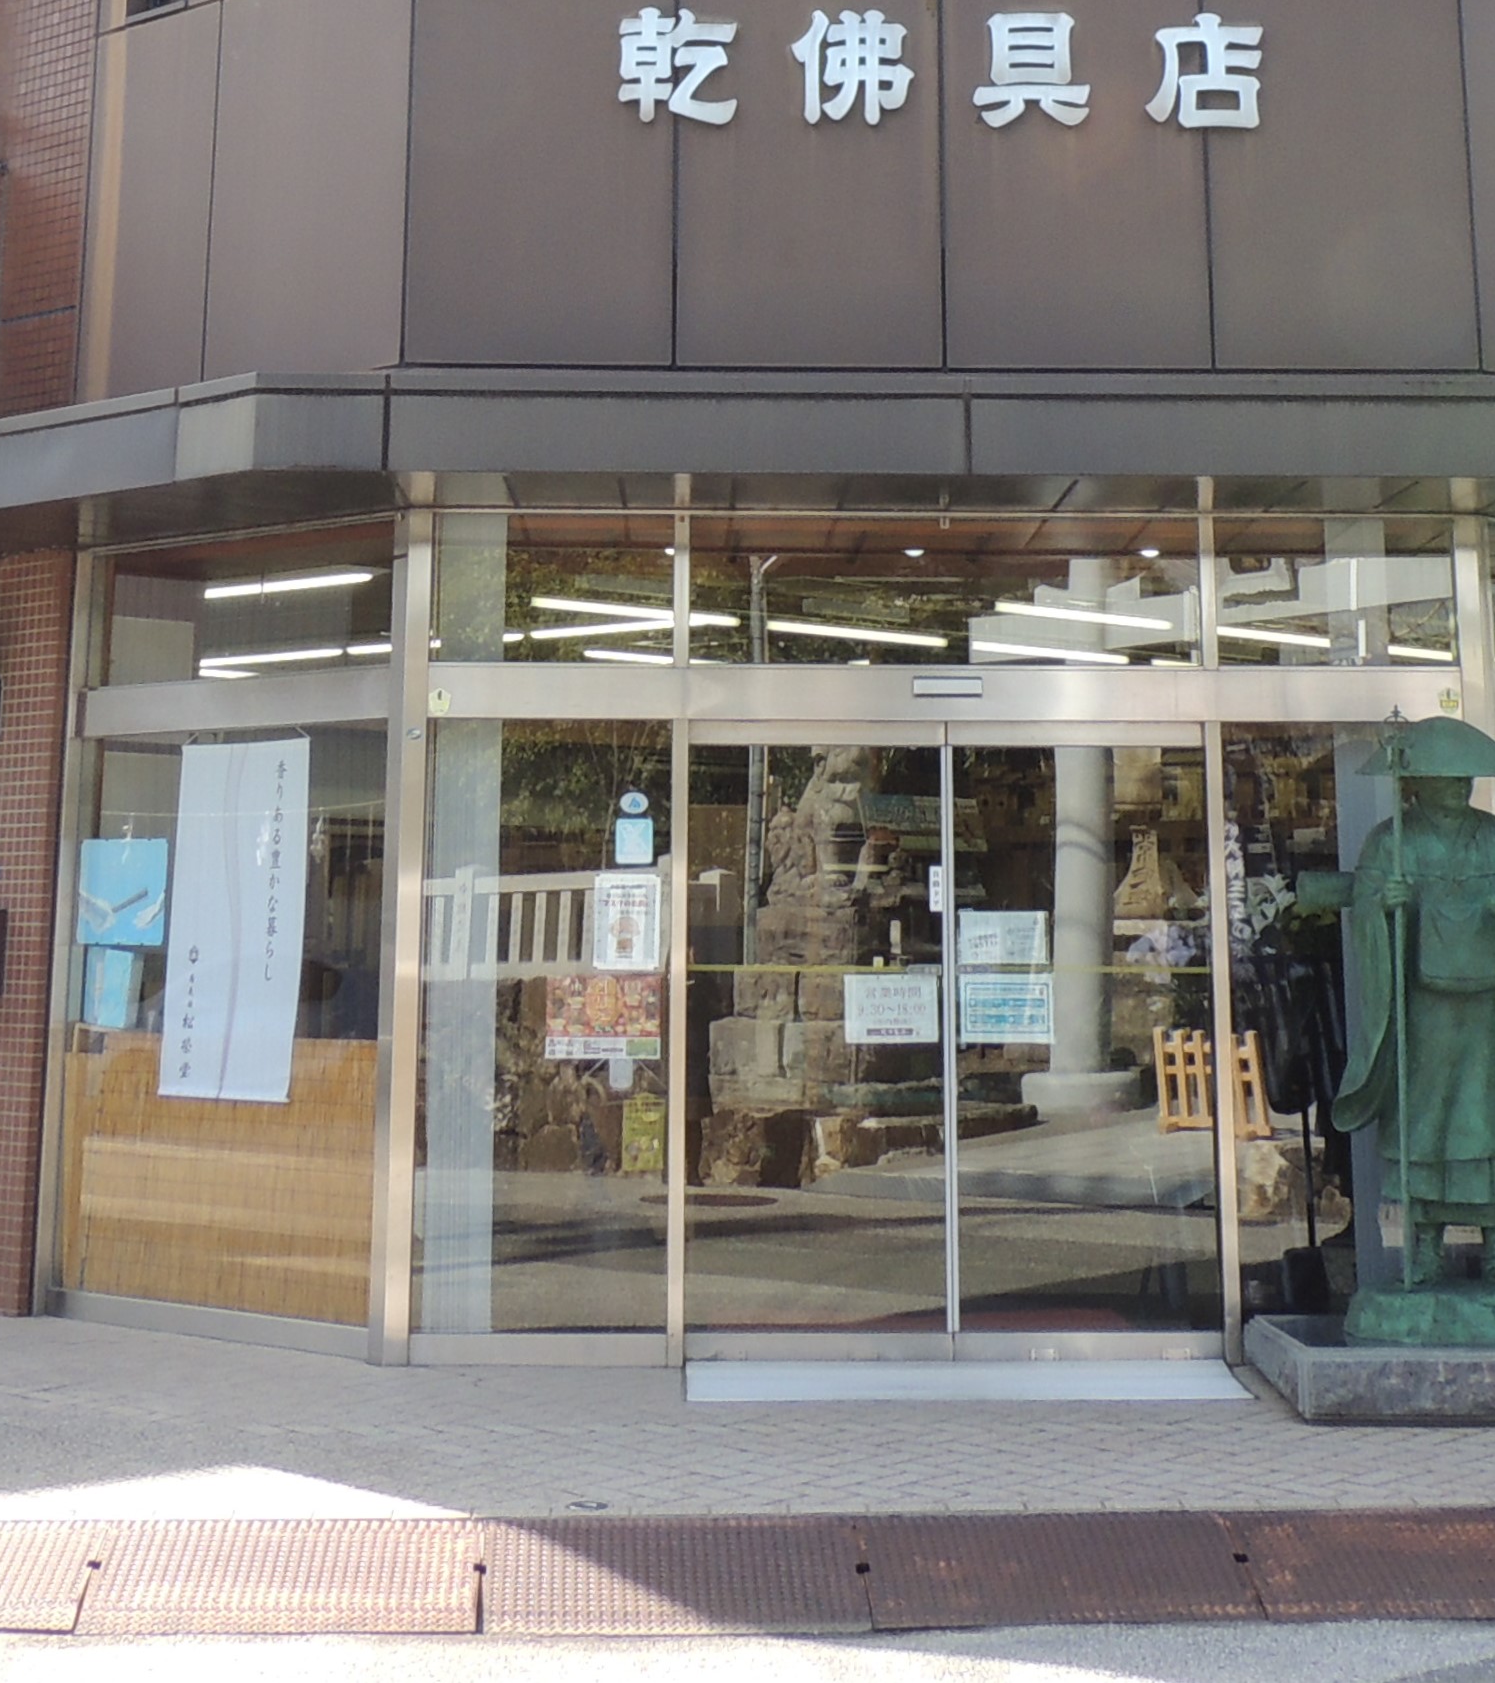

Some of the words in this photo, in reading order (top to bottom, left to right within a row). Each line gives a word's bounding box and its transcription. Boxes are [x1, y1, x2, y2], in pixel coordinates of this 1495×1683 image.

[617, 6, 1264, 129] 乾佛具店
[263, 760, 288, 982] 香りある豊かな暮らし
